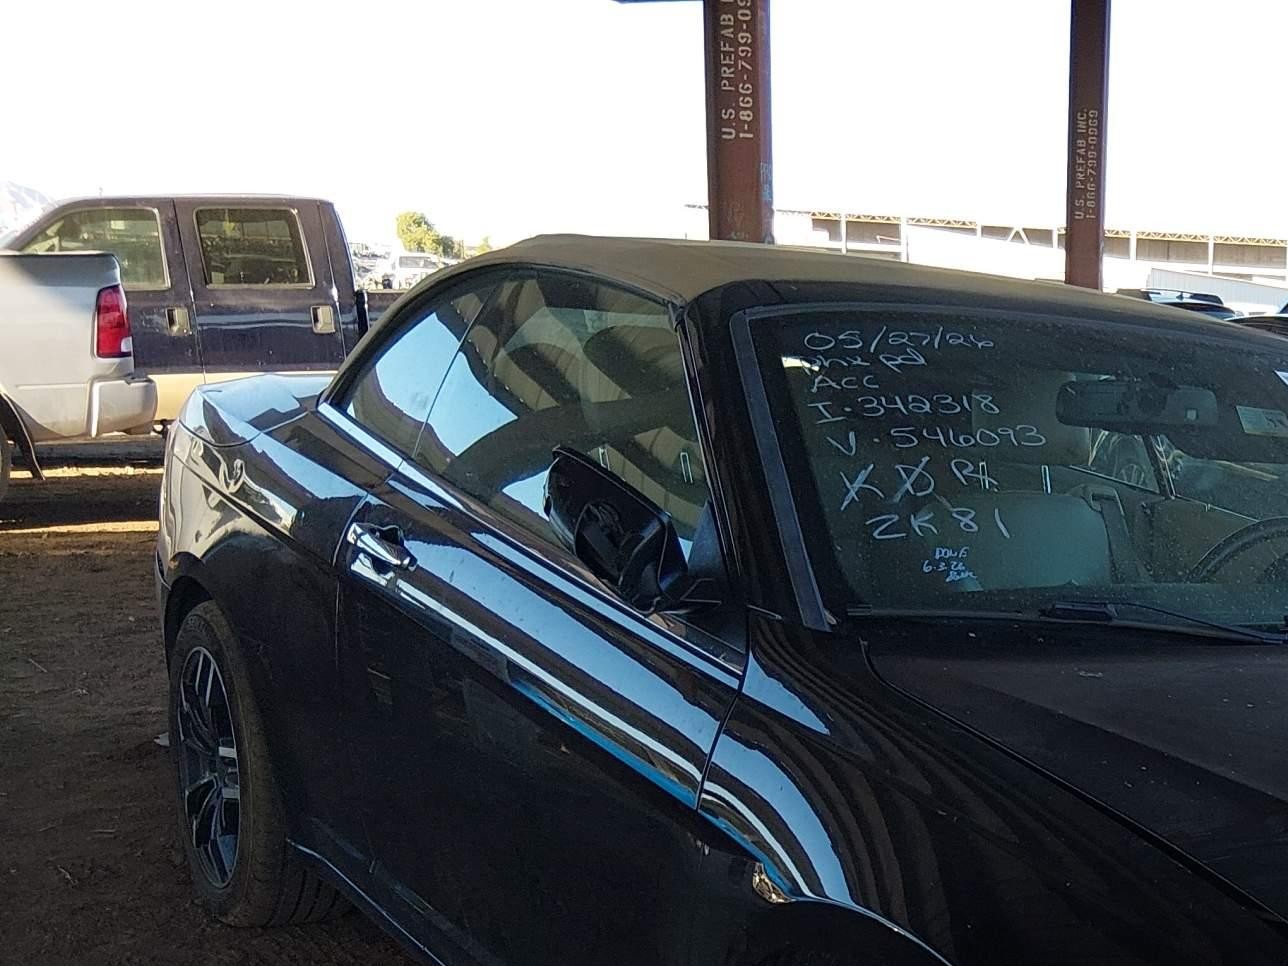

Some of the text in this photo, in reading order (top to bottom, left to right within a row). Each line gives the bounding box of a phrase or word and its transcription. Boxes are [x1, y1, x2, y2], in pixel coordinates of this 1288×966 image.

[720, 13, 735, 91] PREFAB
[721, 103, 736, 140] U.S.
[1077, 108, 1088, 133] INC.
[1075, 139, 1087, 189] PREFAB
[804, 326, 994, 352] 05/27/26
